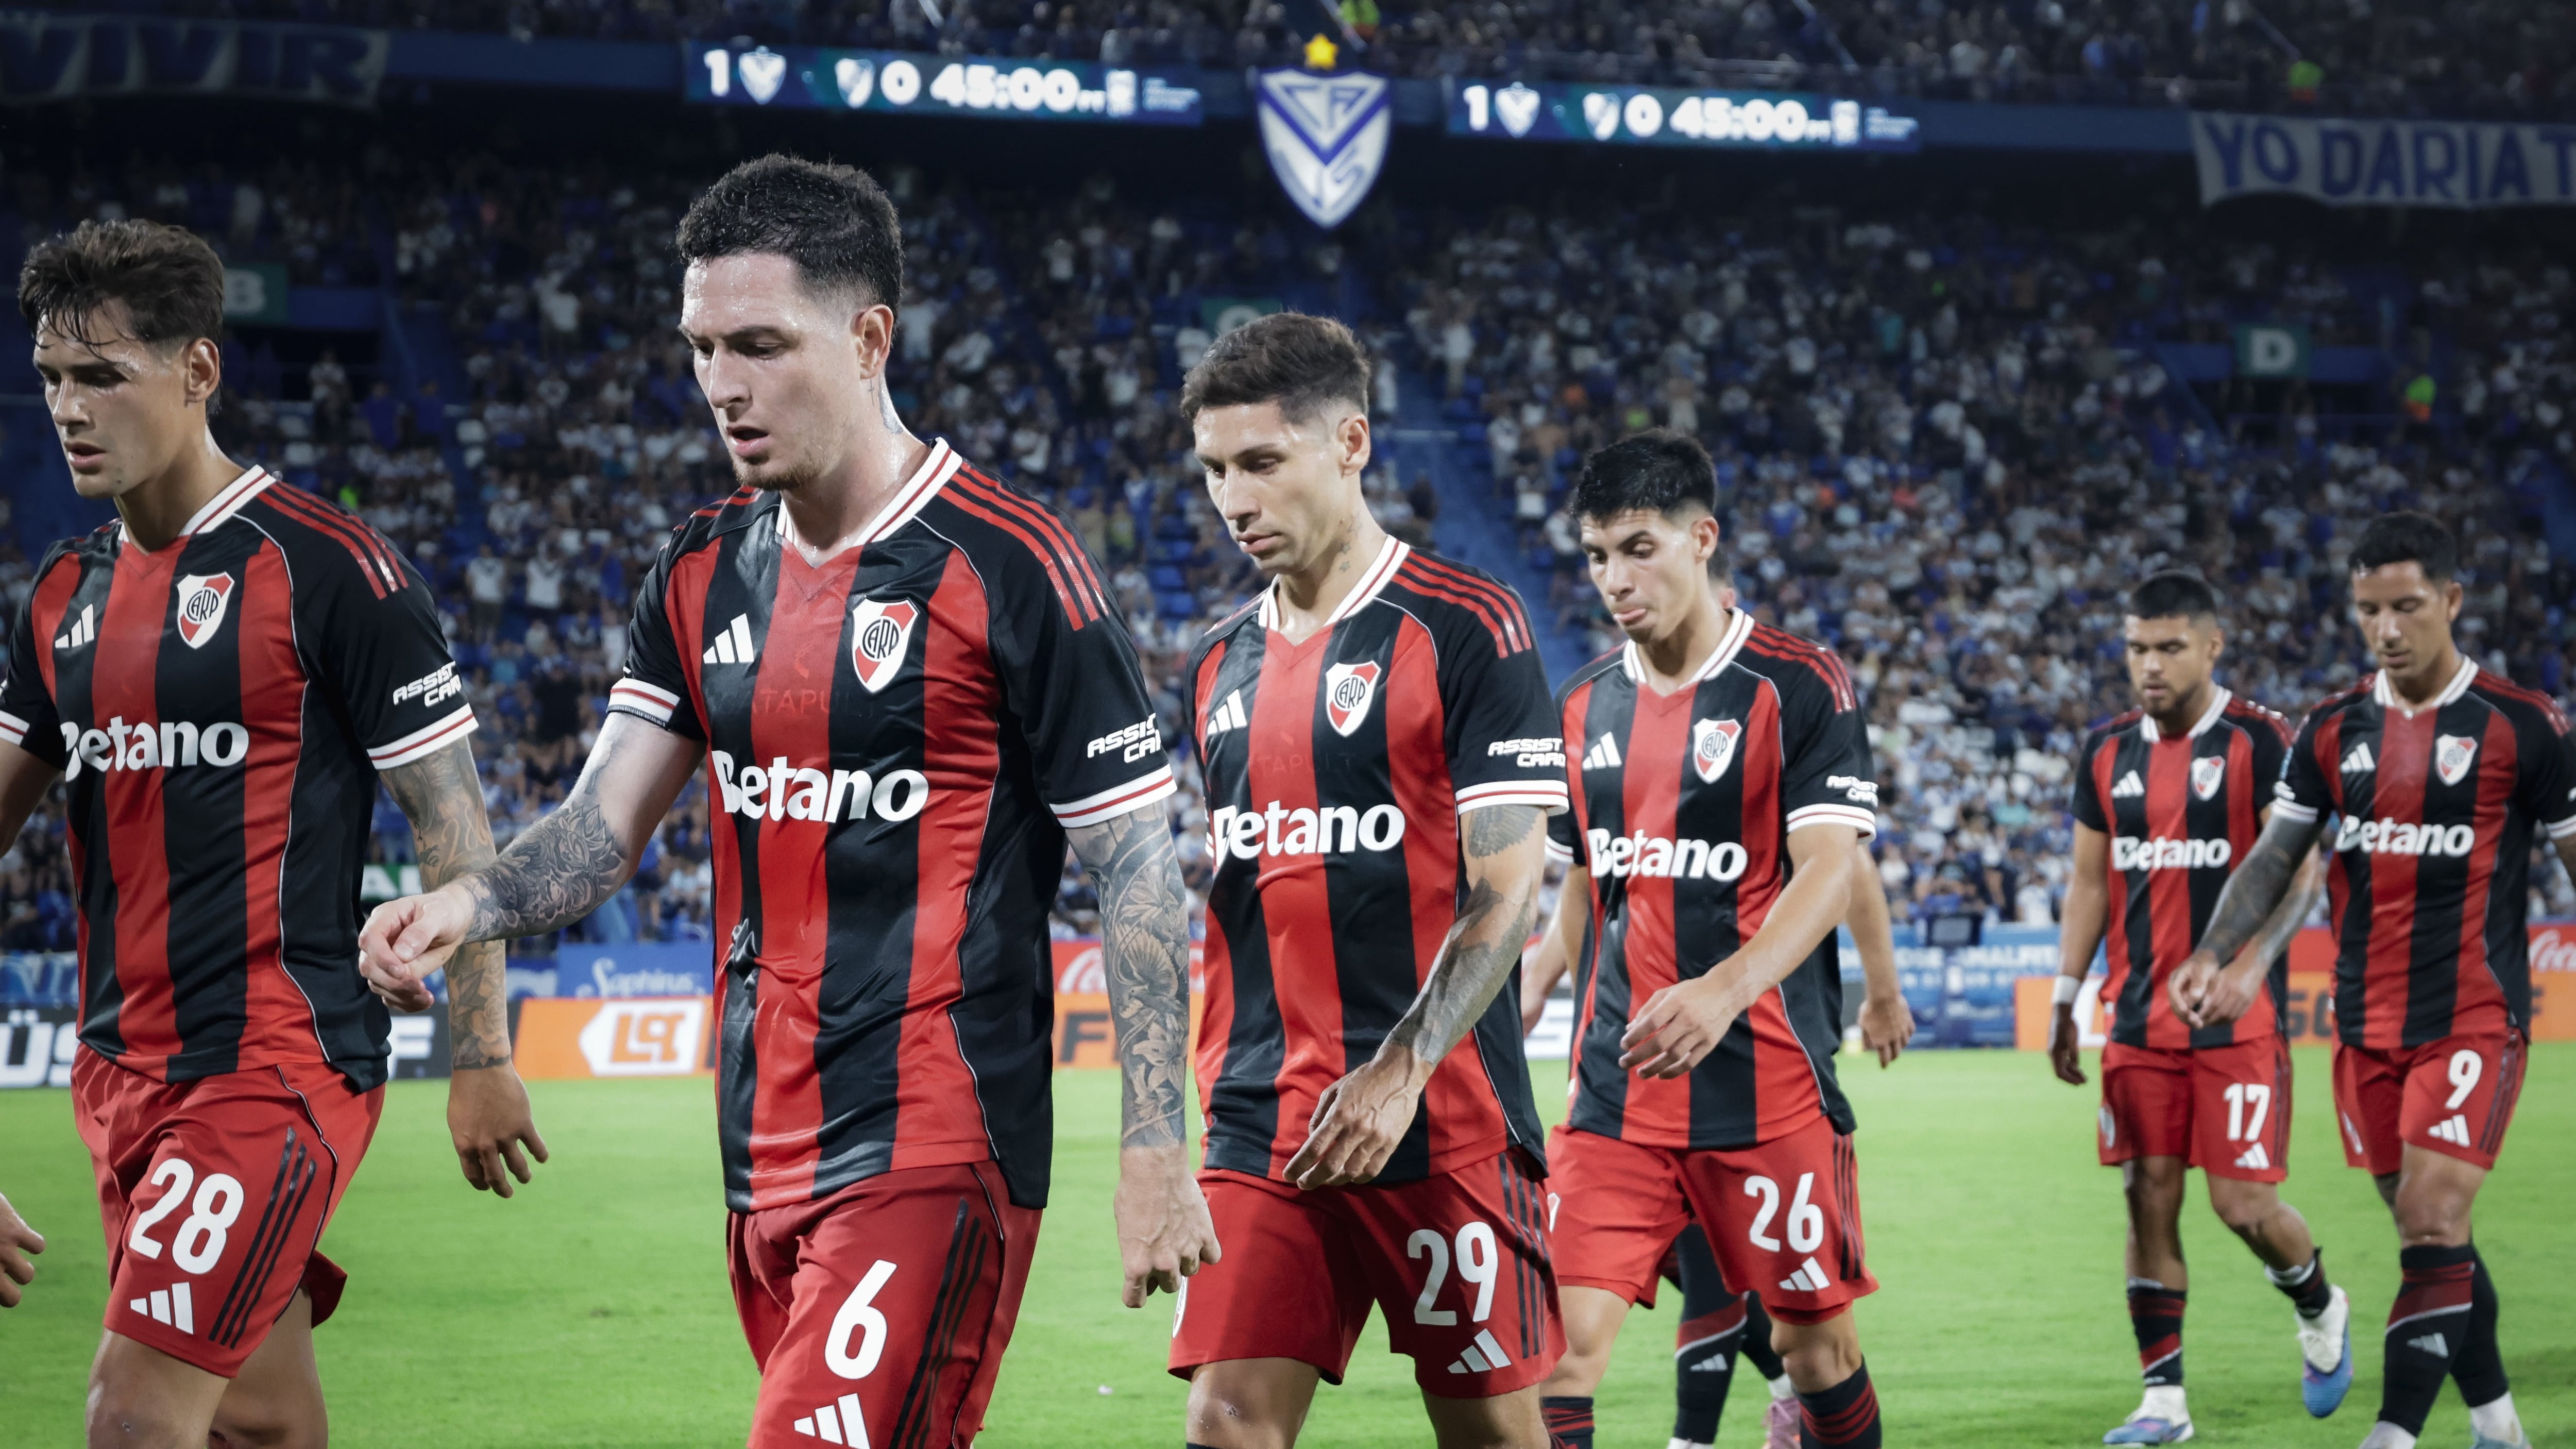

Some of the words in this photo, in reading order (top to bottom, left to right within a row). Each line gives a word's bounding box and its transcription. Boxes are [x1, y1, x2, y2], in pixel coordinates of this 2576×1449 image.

[704, 49, 730, 96] 1
[880, 59, 921, 105] 0
[1463, 85, 1489, 131] 1
[1624, 93, 1663, 137] 0
[2205, 120, 2299, 192] YO
[2249, 329, 2297, 374] D
[862, 618, 900, 659] CARP
[1487, 738, 1563, 756] ASSIST
[1587, 828, 1748, 882] Betano
[2112, 836, 2232, 871] Betano
[2335, 815, 2476, 857] Betano
[2444, 1049, 2483, 1110] 9
[2223, 1083, 2270, 1142] 17
[129, 1158, 244, 1275] 28
[1743, 1171, 1824, 1253] 26
[1407, 1221, 1499, 1326] 29
[824, 1259, 897, 1380] 6
